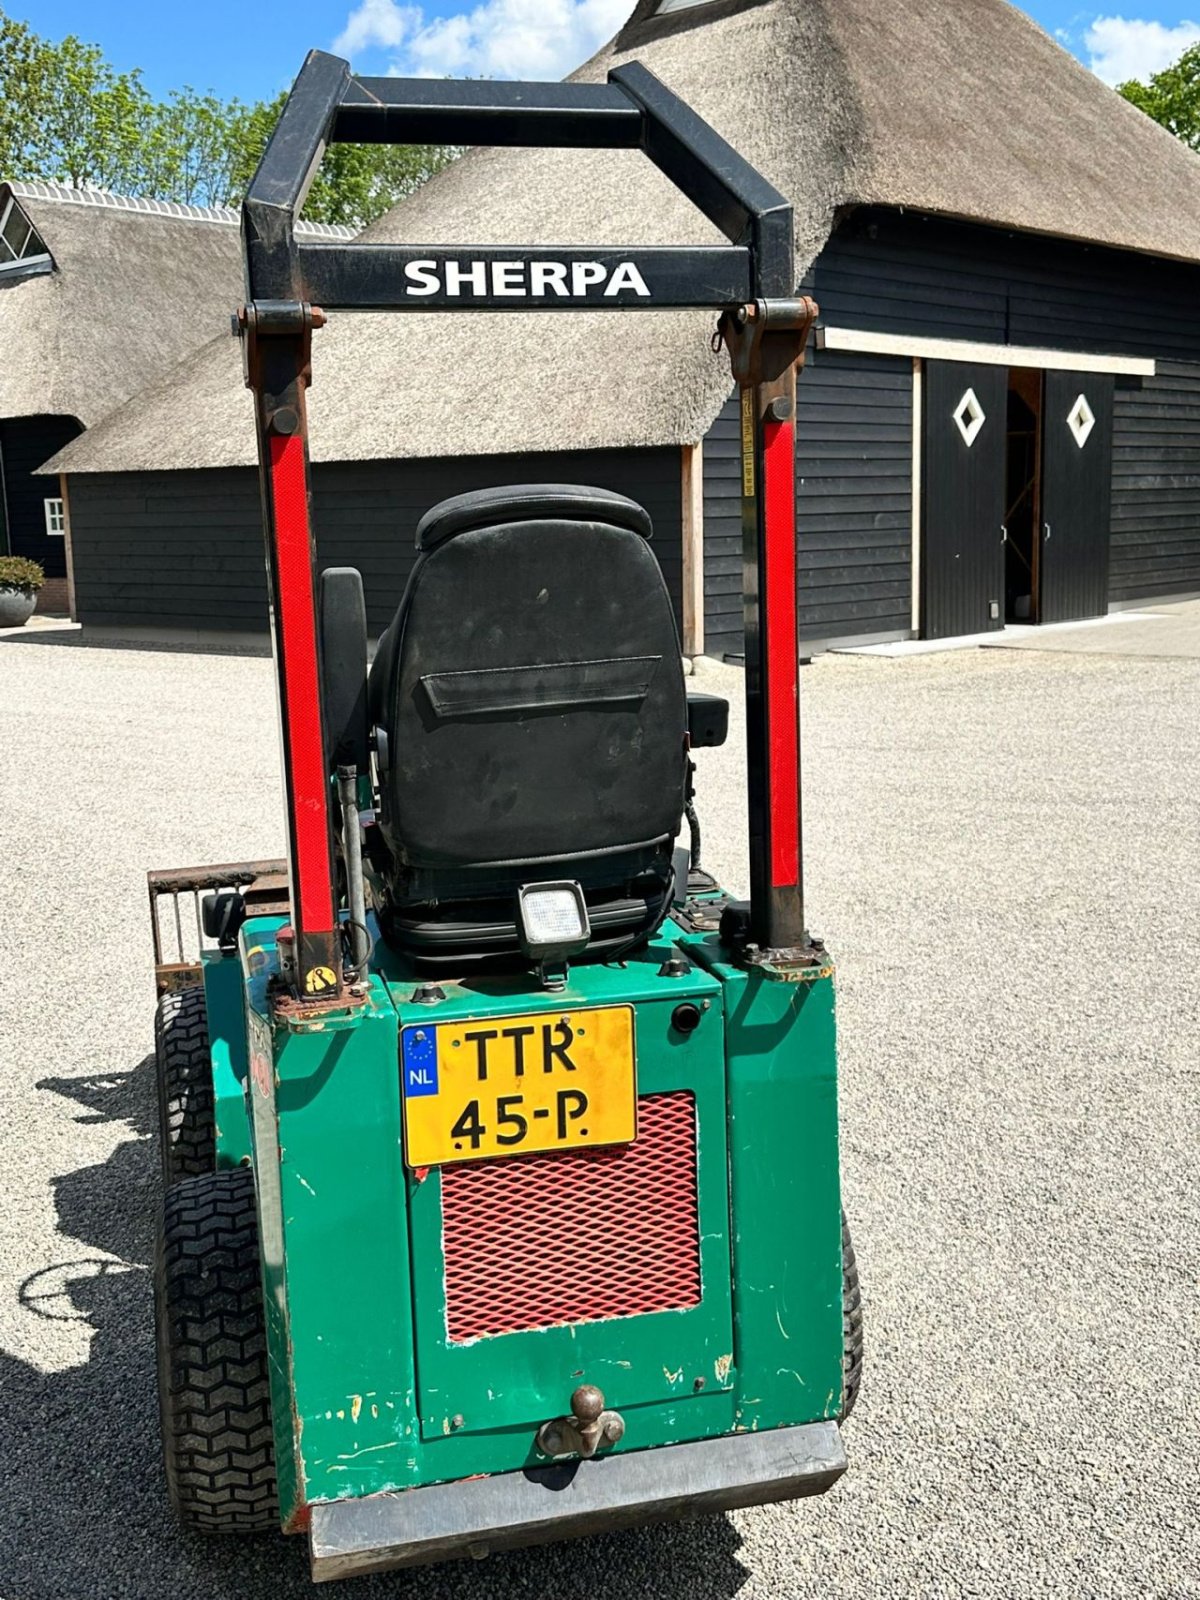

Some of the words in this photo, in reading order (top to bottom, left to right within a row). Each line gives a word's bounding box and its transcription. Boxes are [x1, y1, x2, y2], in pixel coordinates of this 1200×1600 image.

[404, 259, 651, 297] SHERPA
[465, 1023, 576, 1081] TTR
[409, 1069, 433, 1085] NL
[451, 1089, 588, 1149] 45-P
